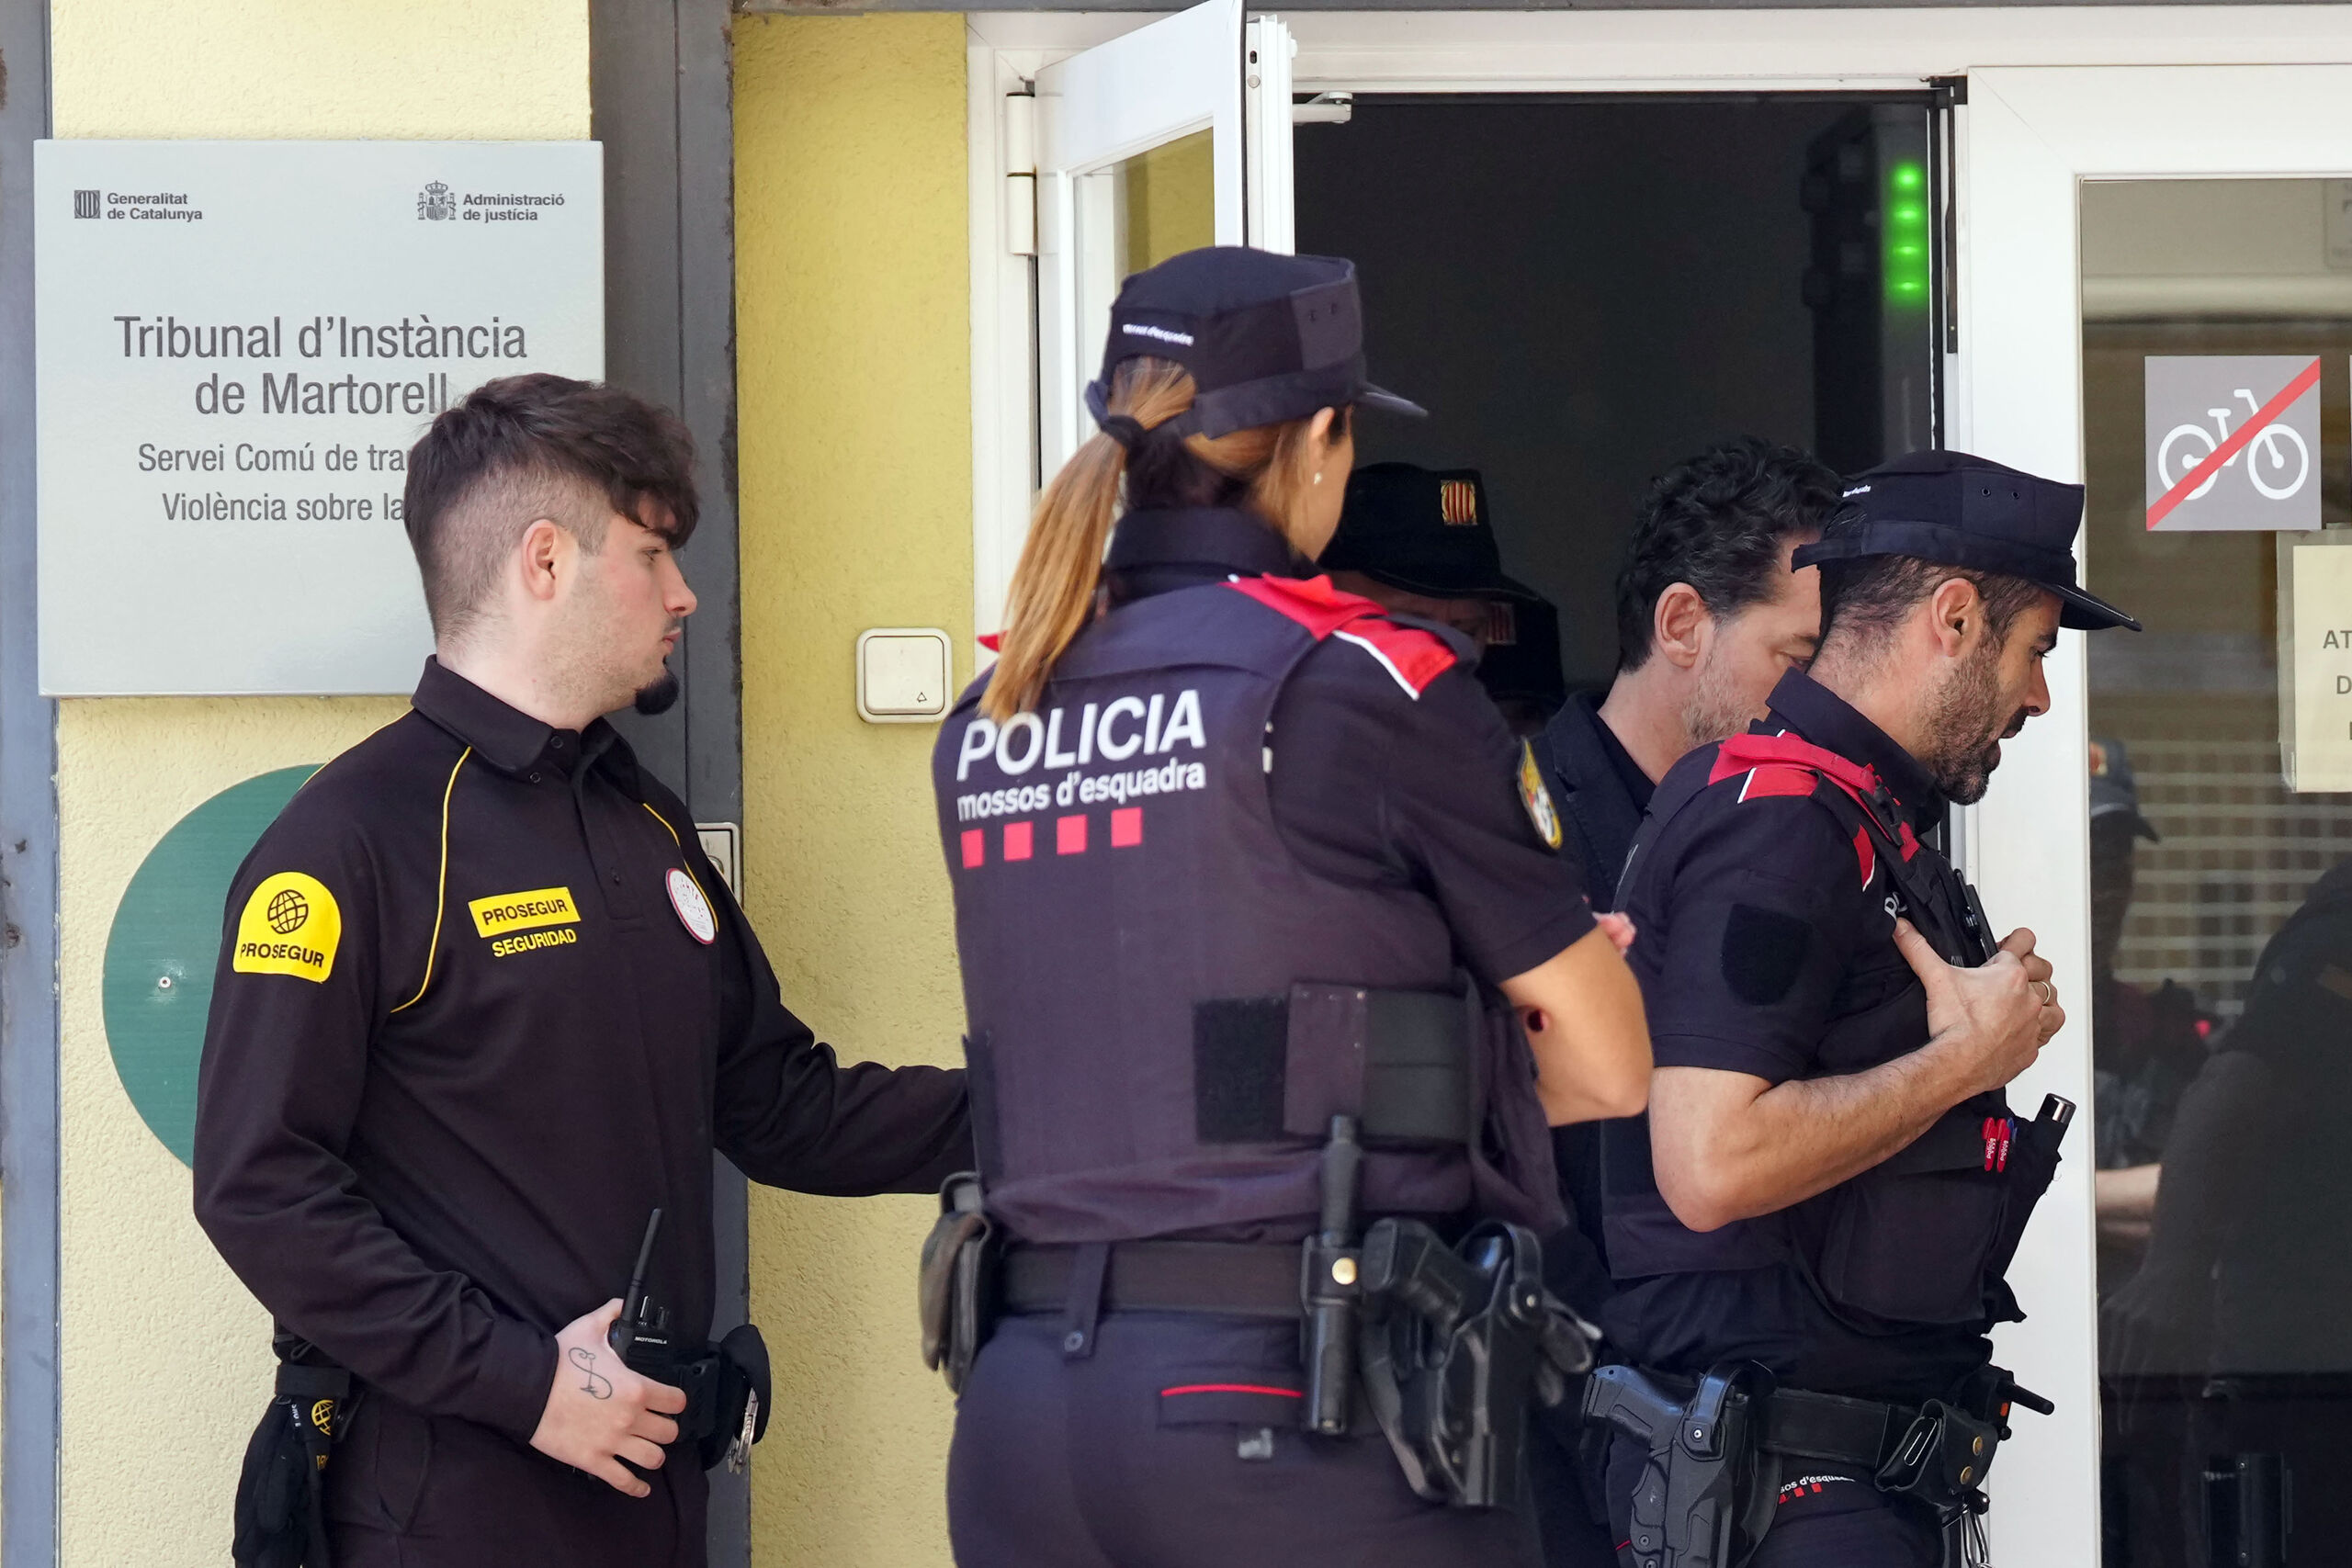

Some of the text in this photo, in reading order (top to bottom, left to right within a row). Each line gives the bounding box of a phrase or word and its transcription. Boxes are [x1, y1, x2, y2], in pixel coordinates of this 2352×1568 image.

[107, 192, 188, 205] Generalitat
[462, 193, 565, 206] Administració
[107, 208, 203, 222] de Catalunya
[462, 209, 538, 223] de justícia
[114, 314, 527, 358] Tribunal d'Instància
[195, 372, 447, 414] de Martorell
[138, 442, 413, 471] Servei Comú de tra
[162, 491, 405, 521] Violència sobre la
[956, 689, 1206, 782] POLICIA
[956, 783, 1051, 822] mossos
[481, 899, 568, 926] PROSEGUR
[240, 942, 324, 968] PROSEGUR
[492, 928, 577, 957] SEGURIDAD
[634, 1336, 668, 1345] MOTOROLA
